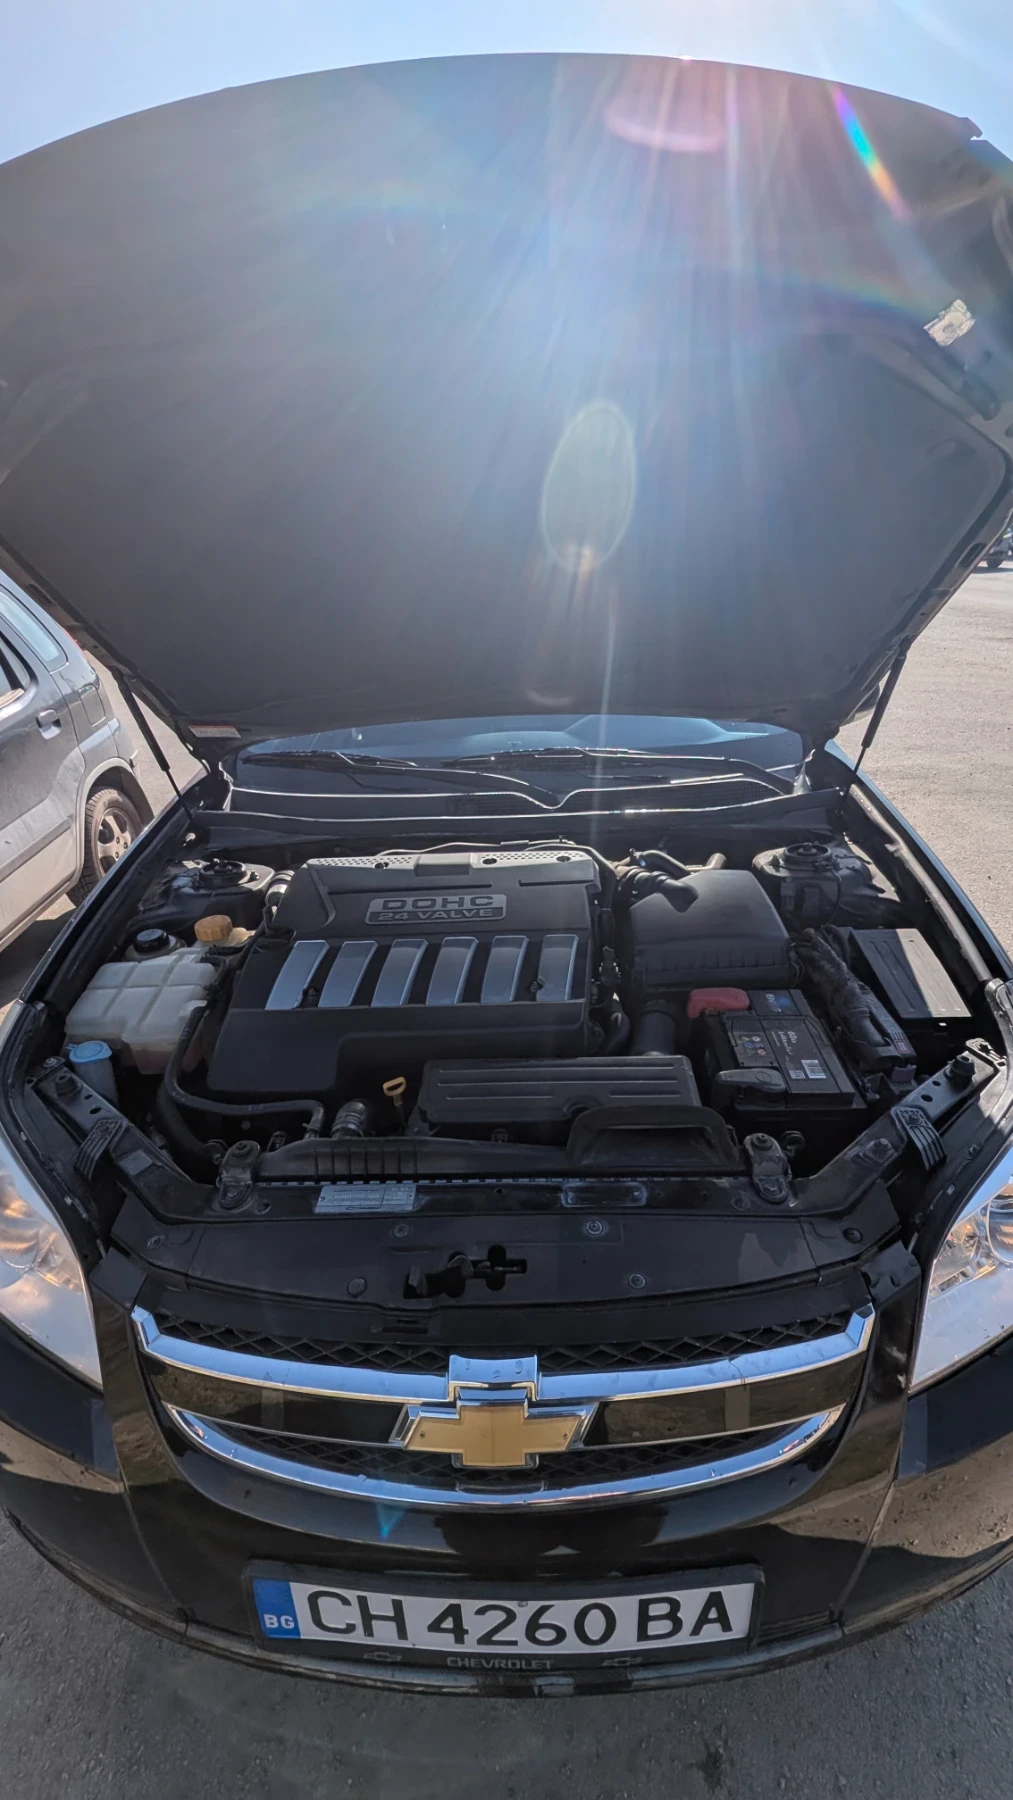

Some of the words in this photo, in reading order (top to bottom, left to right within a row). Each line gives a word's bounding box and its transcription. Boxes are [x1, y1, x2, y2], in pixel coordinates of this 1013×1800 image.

[381, 895, 494, 911] DOHC
[378, 911, 409, 921] 24
[417, 908, 493, 921] VALVE
[264, 1613, 296, 1630] BG
[307, 1589, 409, 1642] CH
[426, 1602, 617, 1647] 4260
[636, 1589, 734, 1643] BA
[446, 1656, 554, 1670] CHEVROLET
